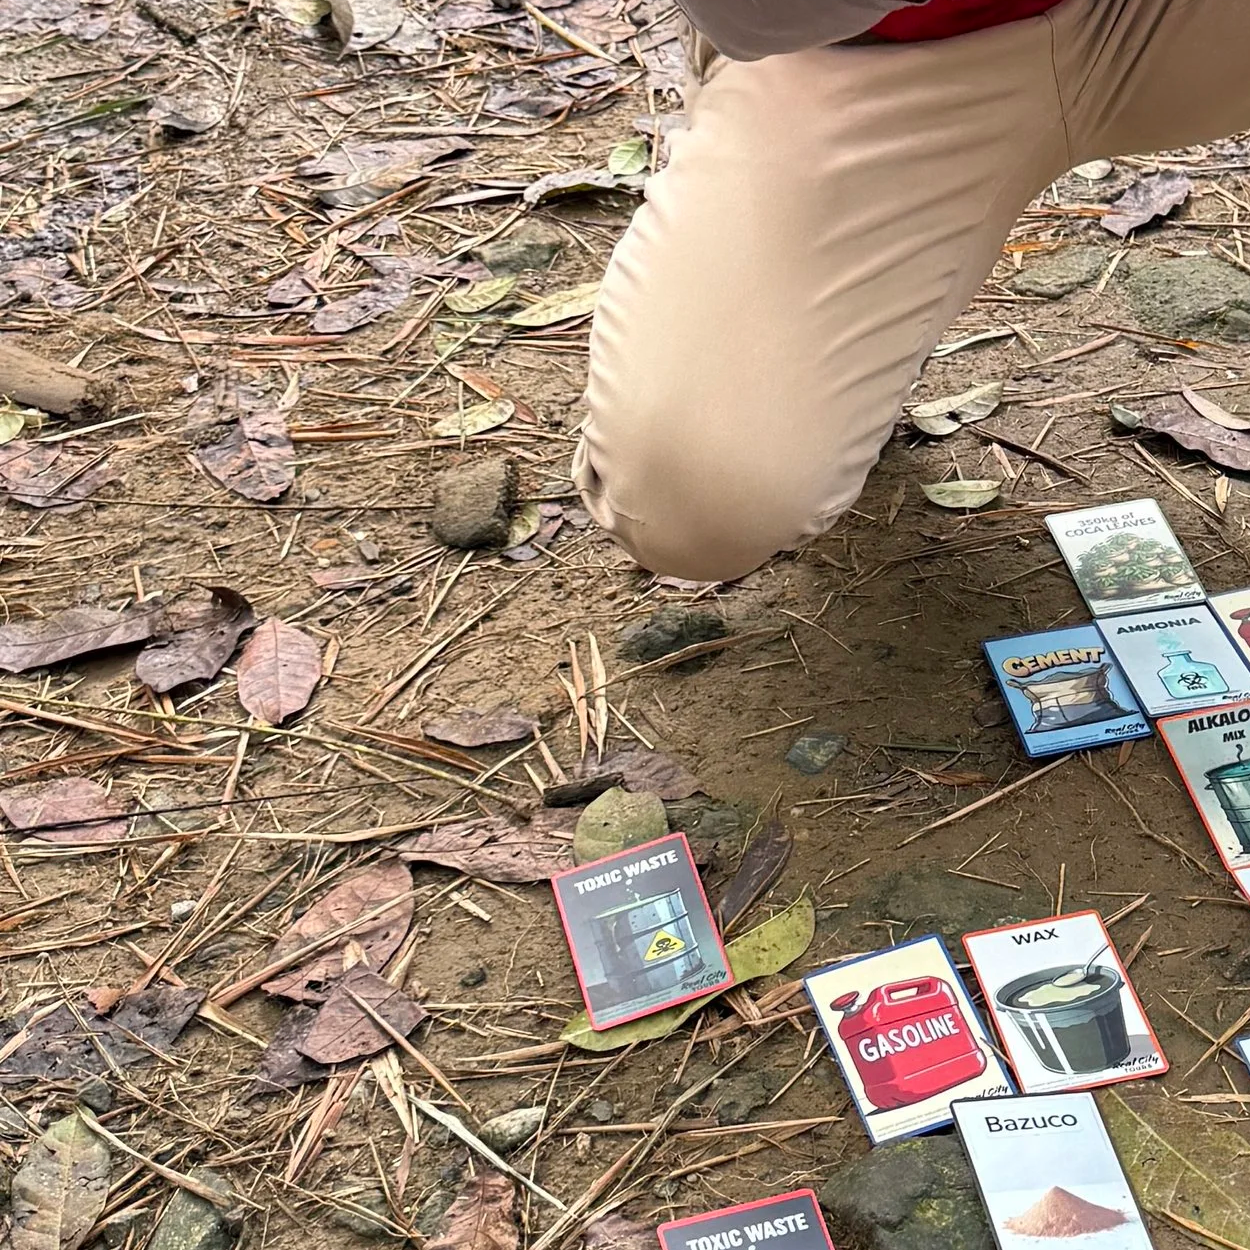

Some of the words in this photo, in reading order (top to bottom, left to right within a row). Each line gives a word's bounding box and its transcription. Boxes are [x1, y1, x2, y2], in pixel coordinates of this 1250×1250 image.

[1065, 527, 1104, 538] COCA
[1106, 517, 1157, 531] LEAVES
[1077, 516, 1118, 528] 350kg
[1121, 512, 1135, 520] of
[1116, 617, 1201, 635] AMMONIA
[1003, 646, 1105, 677] CEMENT
[1105, 724, 1127, 734] Real
[1127, 722, 1146, 730] City
[1222, 730, 1246, 743] MIX
[574, 869, 622, 895] TOXIC
[623, 850, 679, 878] WASTE
[1011, 927, 1060, 945] WAX
[681, 974, 705, 991] Real
[706, 969, 727, 981] City
[858, 1013, 960, 1062] GASOLINE
[1138, 1054, 1159, 1065] City
[984, 1114, 1078, 1133] Bazuco
[686, 1230, 743, 1250] TOXIC
[744, 1213, 809, 1243] WASTE
